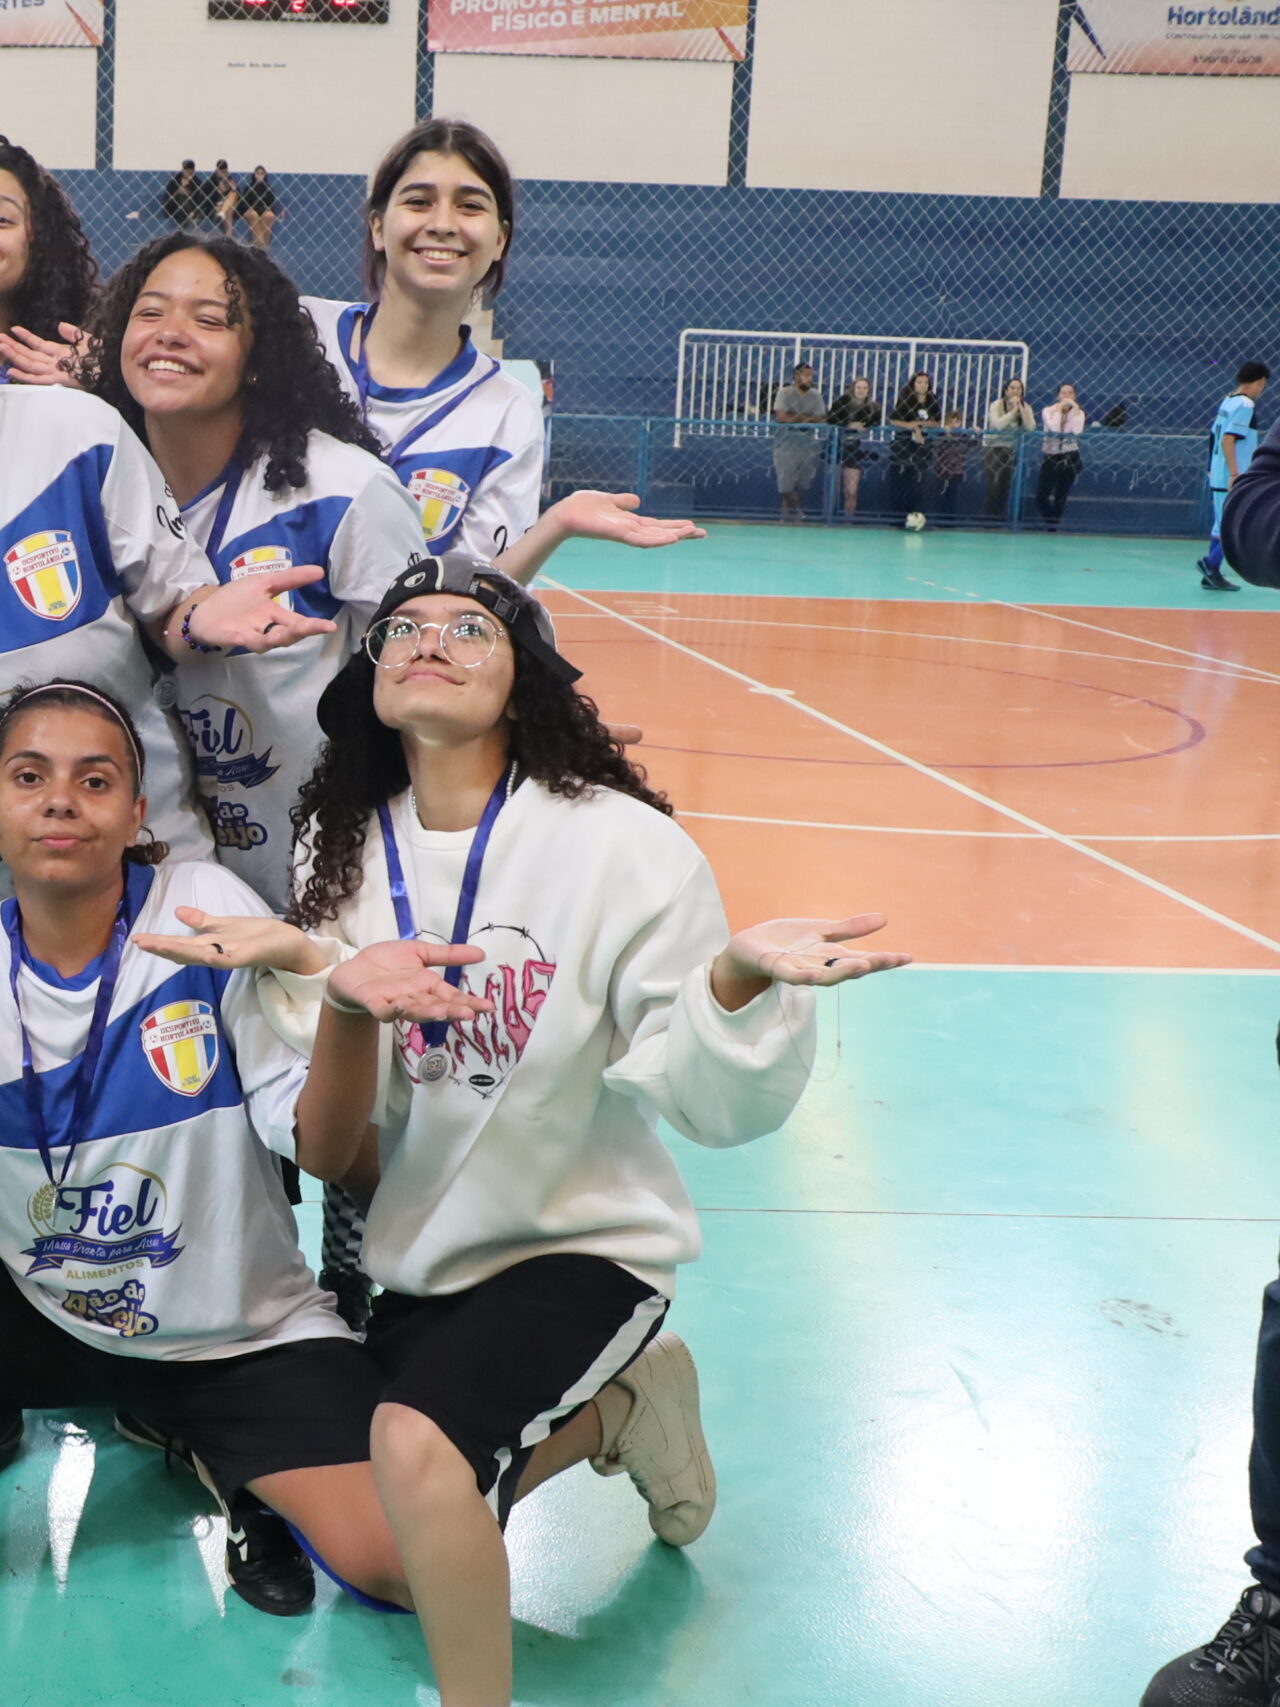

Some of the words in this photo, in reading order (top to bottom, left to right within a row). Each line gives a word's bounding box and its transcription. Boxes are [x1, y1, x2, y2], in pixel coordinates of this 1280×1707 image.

[491, 10, 567, 31] FÍSICO
[572, 9, 585, 25] E
[590, 1, 684, 24] MENTAL
[160, 1017, 200, 1034] DESPORTIVO
[57, 1178, 158, 1236] Fiel
[42, 1239, 72, 1252] Massa
[108, 1245, 133, 1260] para
[66, 1258, 145, 1280] ALIMENTOS
